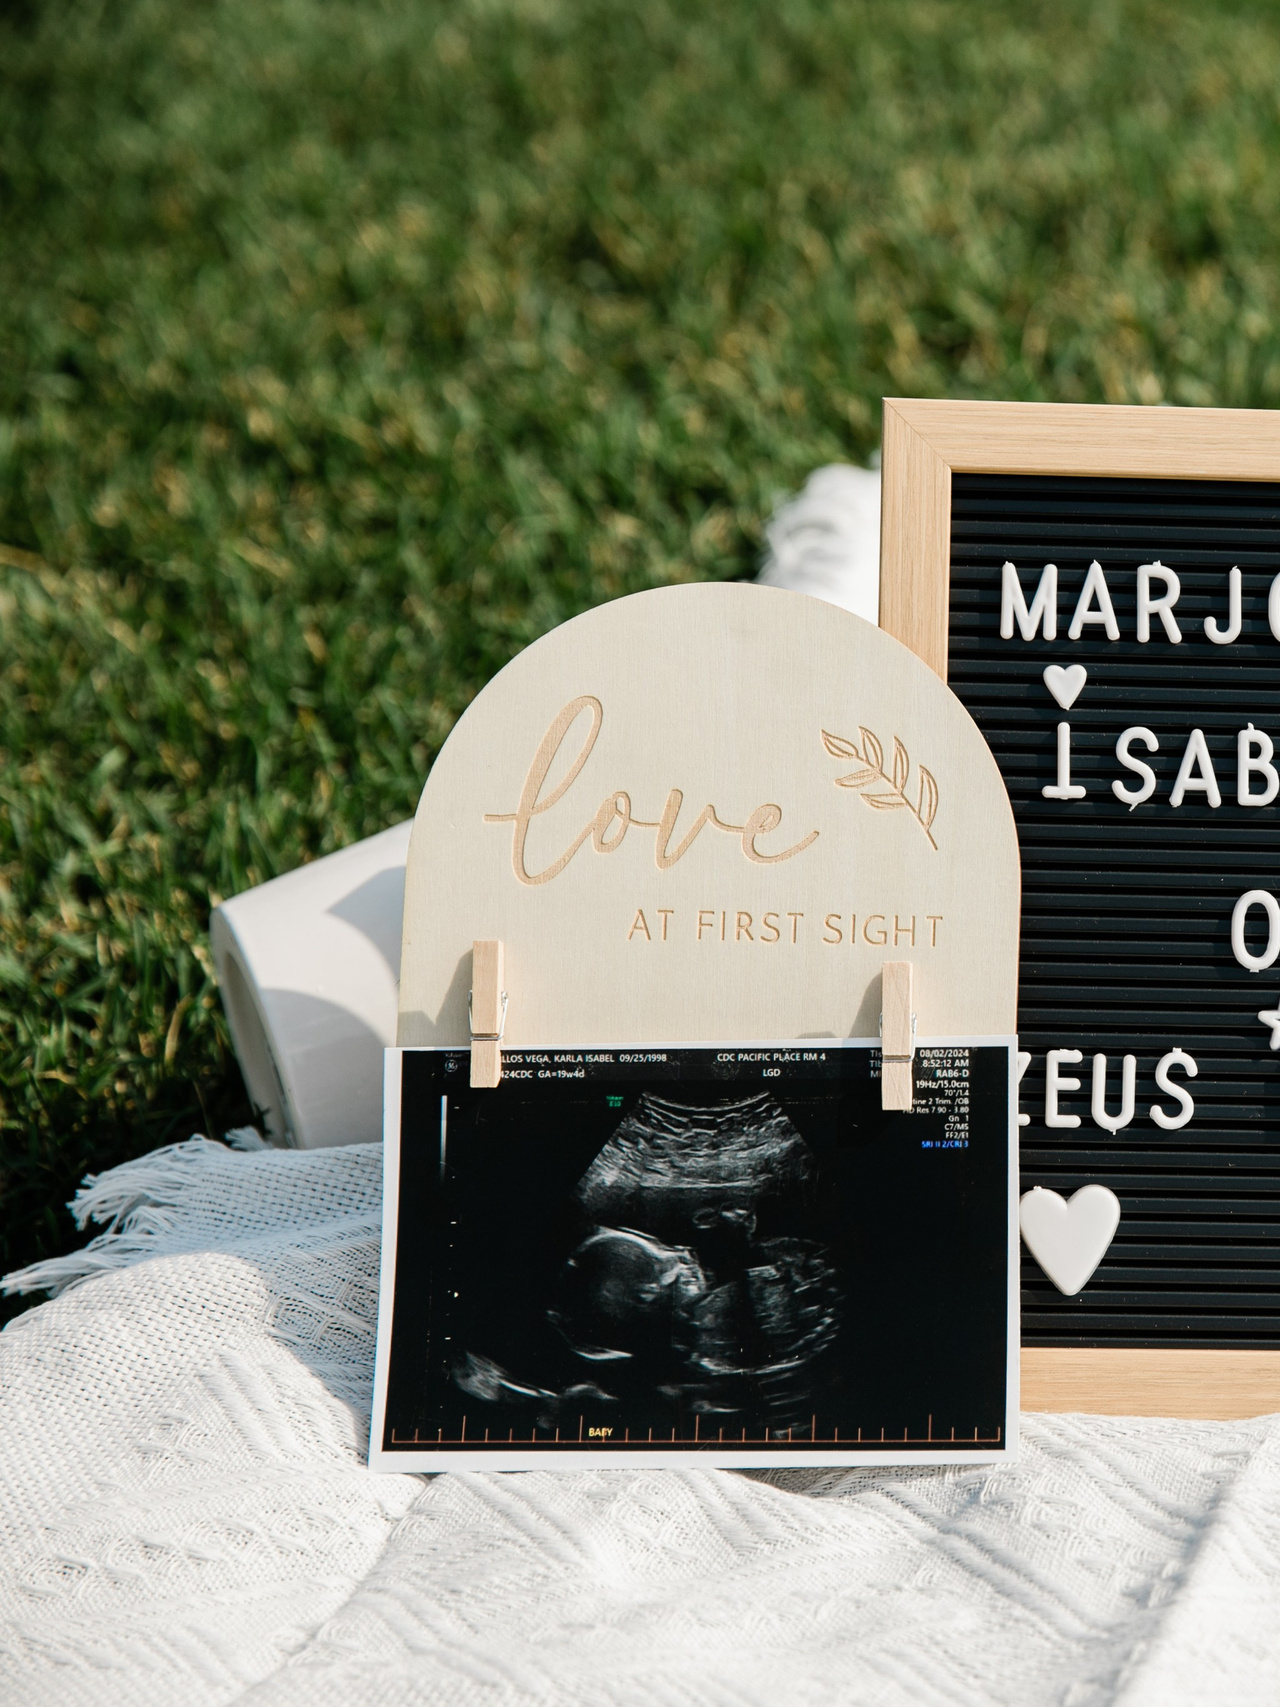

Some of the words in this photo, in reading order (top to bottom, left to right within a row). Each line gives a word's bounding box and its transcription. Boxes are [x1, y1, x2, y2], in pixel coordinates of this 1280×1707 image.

[482, 695, 821, 886] love
[627, 909, 675, 942] AT
[696, 910, 804, 944] FIRST
[822, 914, 944, 948] SIGHT
[717, 1053, 736, 1062] CDC
[738, 1053, 771, 1062] PACIFIC
[774, 1053, 801, 1062] PLACE
[803, 1053, 818, 1061] RM
[820, 1053, 826, 1061] 4
[919, 1049, 970, 1058] 08/02/2024
[525, 1054, 552, 1064] VEGA,
[554, 1054, 583, 1063] KARLA
[585, 1053, 615, 1063] ISABEL
[619, 1053, 668, 1064] 09/25/1998
[922, 1059, 952, 1068] 8:52:12
[953, 1059, 970, 1068] AM
[763, 1068, 781, 1077] LGD
[935, 1069, 970, 1078] RAB6-D
[915, 1080, 970, 1089] 19Hz/15.0cm
[588, 1427, 614, 1437] BABY
